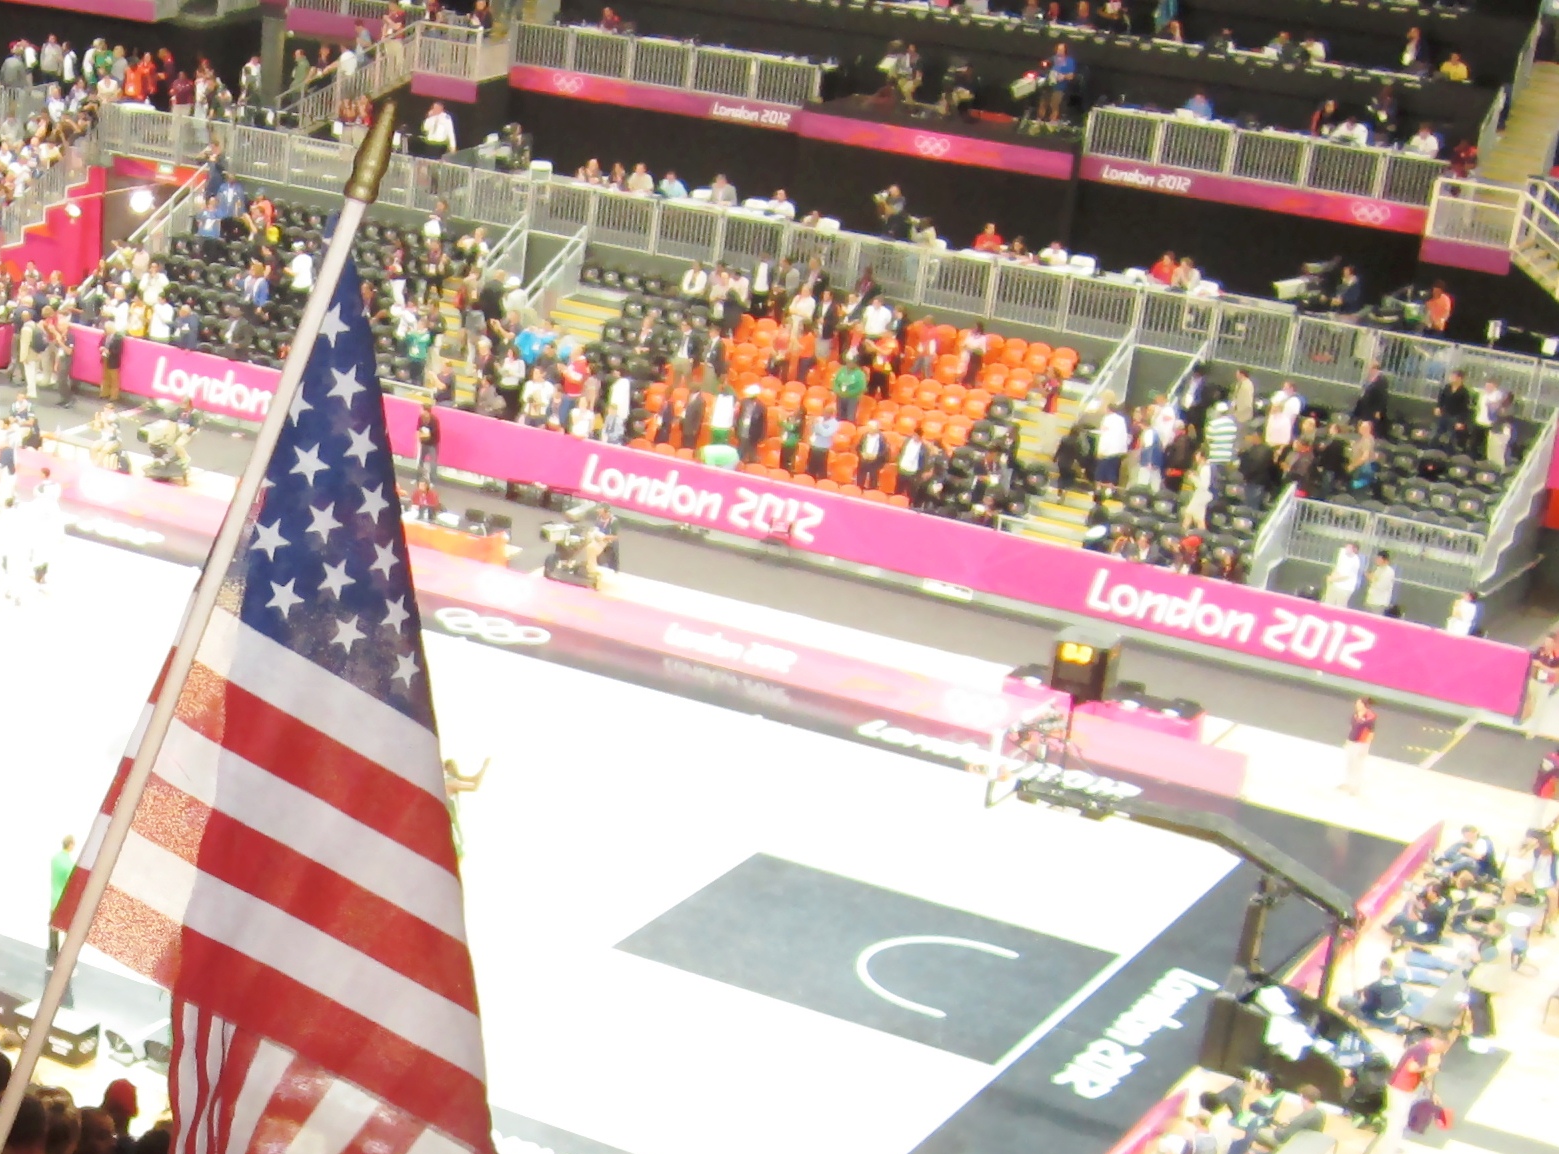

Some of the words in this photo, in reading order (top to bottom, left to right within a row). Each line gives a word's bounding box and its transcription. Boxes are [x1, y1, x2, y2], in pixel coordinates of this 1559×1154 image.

[712, 101, 759, 122] London
[760, 109, 791, 126] 2012
[1102, 164, 1155, 188] London
[1157, 173, 1192, 193] 2012
[152, 356, 273, 415] London
[580, 453, 724, 521] London
[727, 486, 825, 544] 2012
[1086, 568, 1256, 644] London
[1262, 606, 1378, 671] 2012
